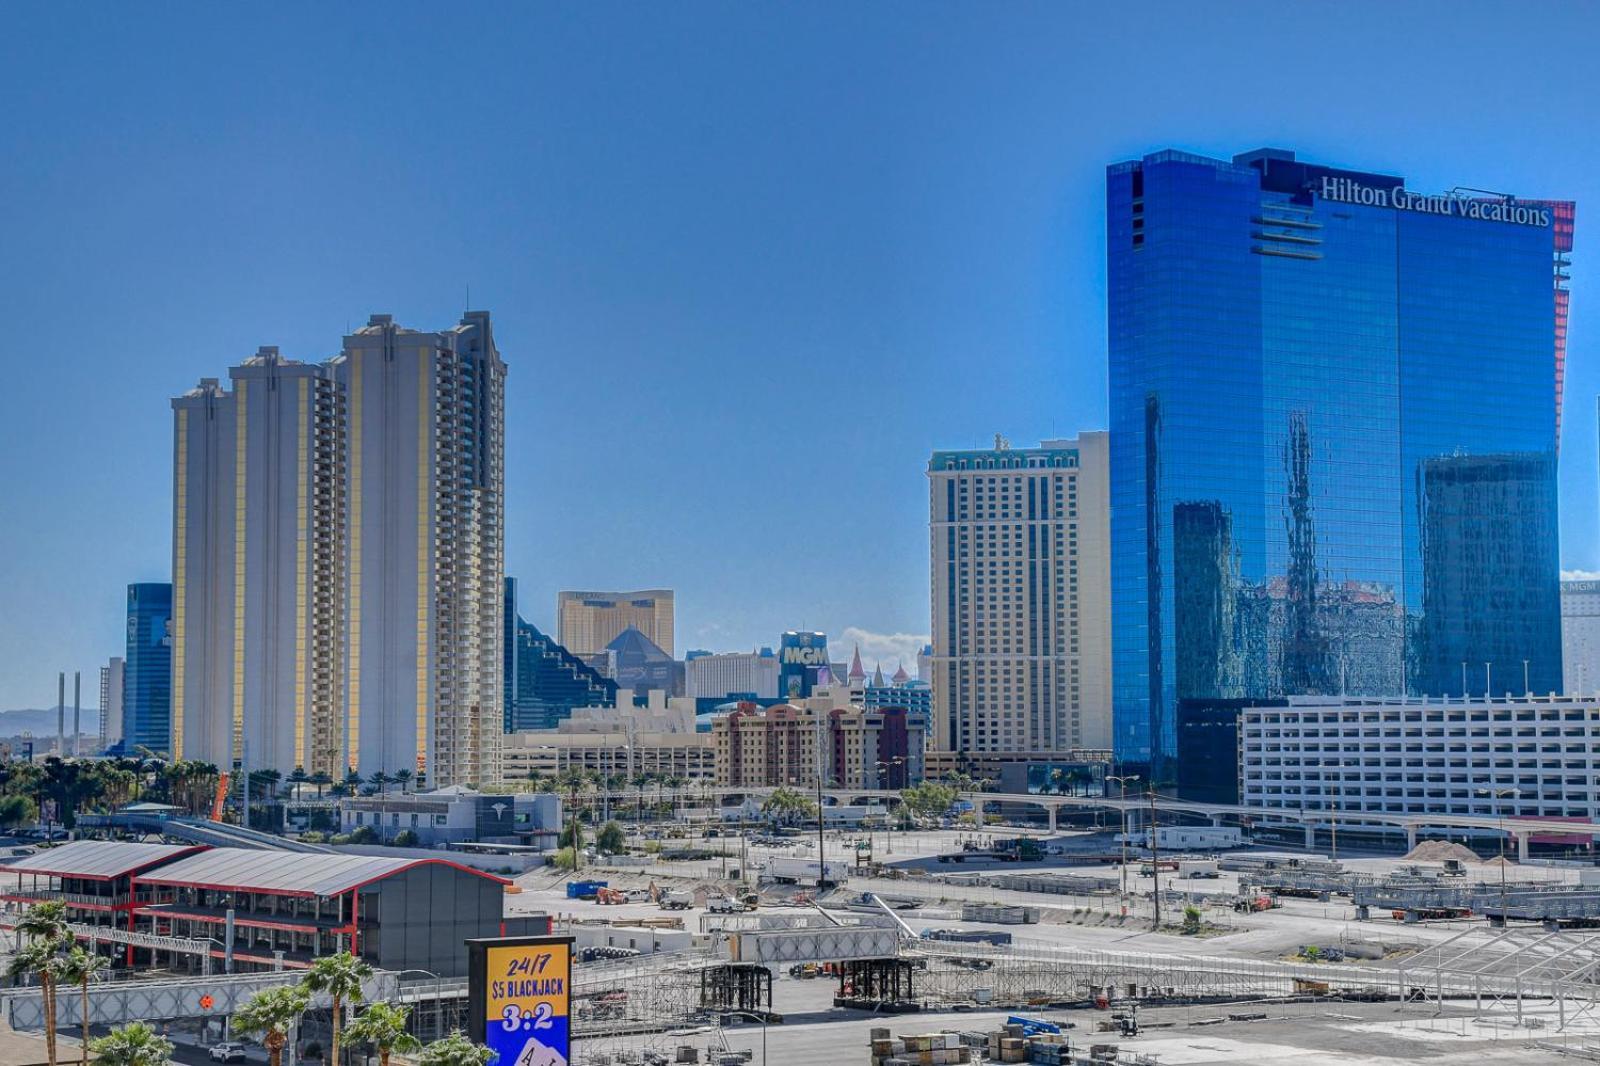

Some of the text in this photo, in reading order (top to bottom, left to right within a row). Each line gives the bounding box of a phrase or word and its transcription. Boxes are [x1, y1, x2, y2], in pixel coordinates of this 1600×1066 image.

[1321, 176, 1549, 226] Hilton Grand Vacations
[784, 647, 827, 664] MGM
[507, 953, 551, 976] 24/7
[492, 978, 563, 1000] $5 BLACKJACK
[502, 1002, 553, 1032] 3:2
